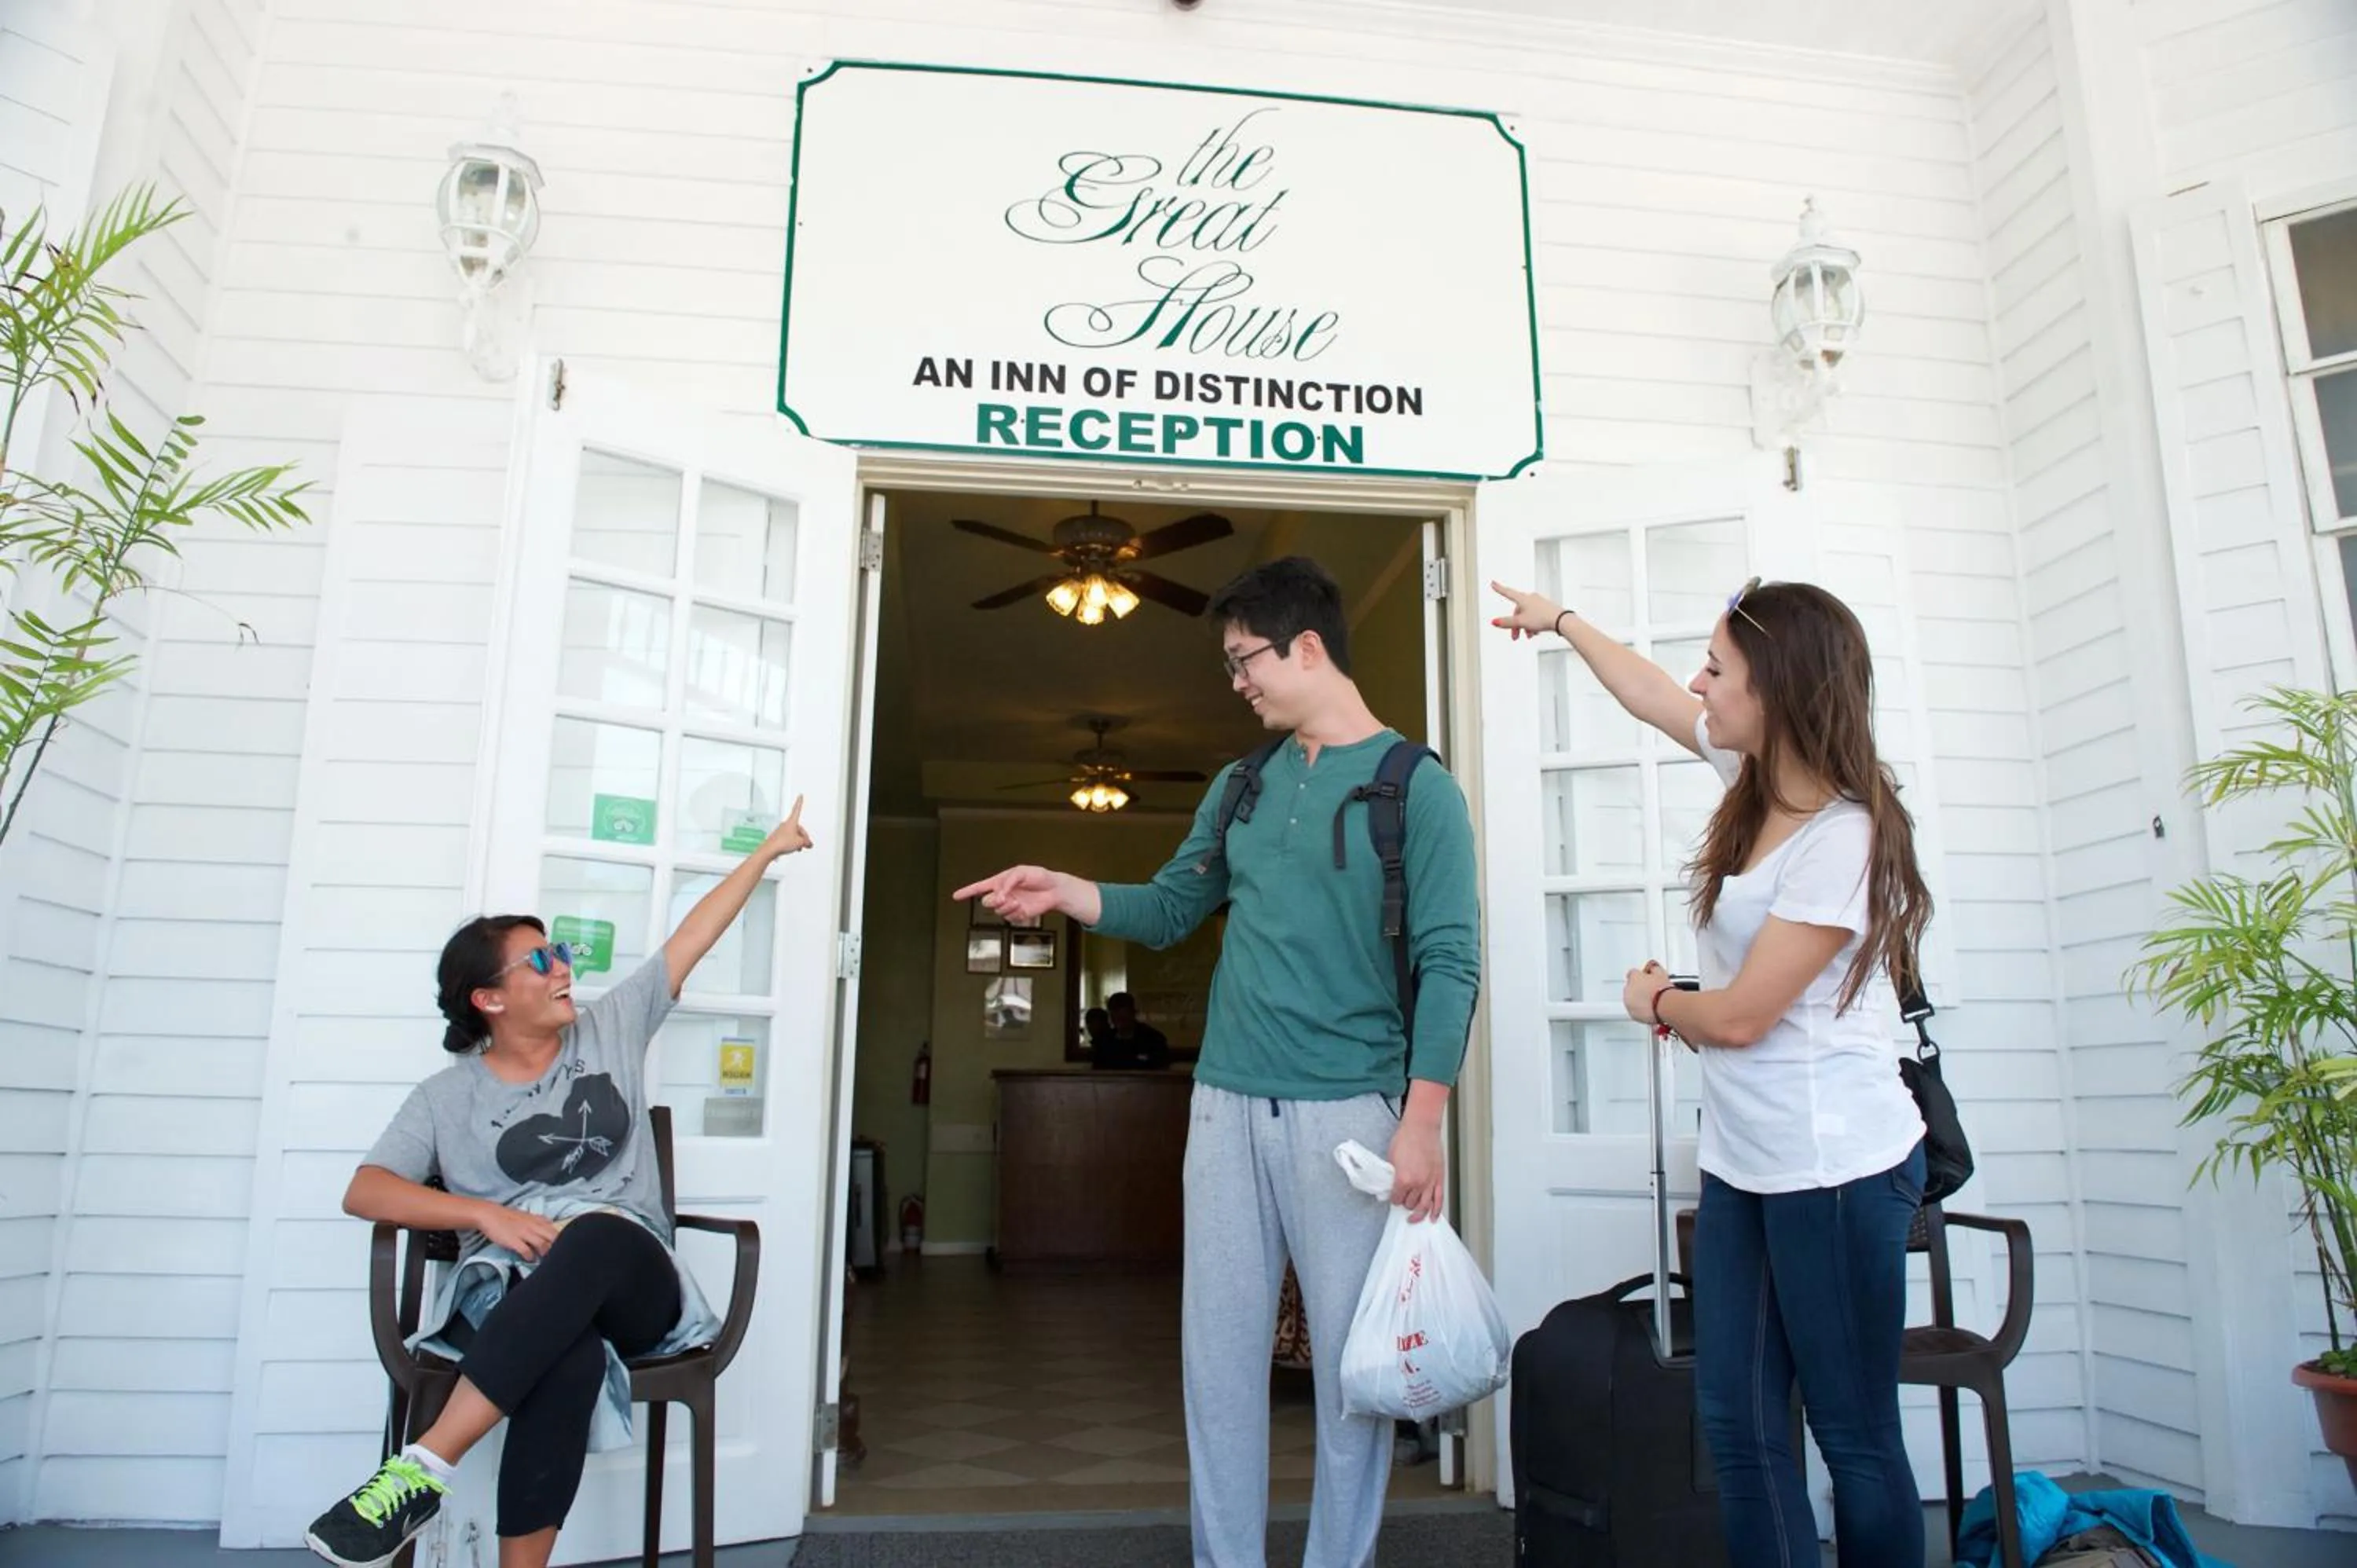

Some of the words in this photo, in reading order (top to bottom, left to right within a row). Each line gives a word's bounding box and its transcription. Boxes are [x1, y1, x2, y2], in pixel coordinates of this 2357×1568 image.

[1176, 107, 1281, 189] the
[1005, 151, 1288, 252] Great
[1044, 255, 1340, 361] House
[911, 356, 973, 389] AN
[991, 360, 1066, 395] INN
[1083, 366, 1138, 399] OF
[1154, 369, 1423, 416] DISTINCTION
[976, 402, 1365, 465] RECEPTION
